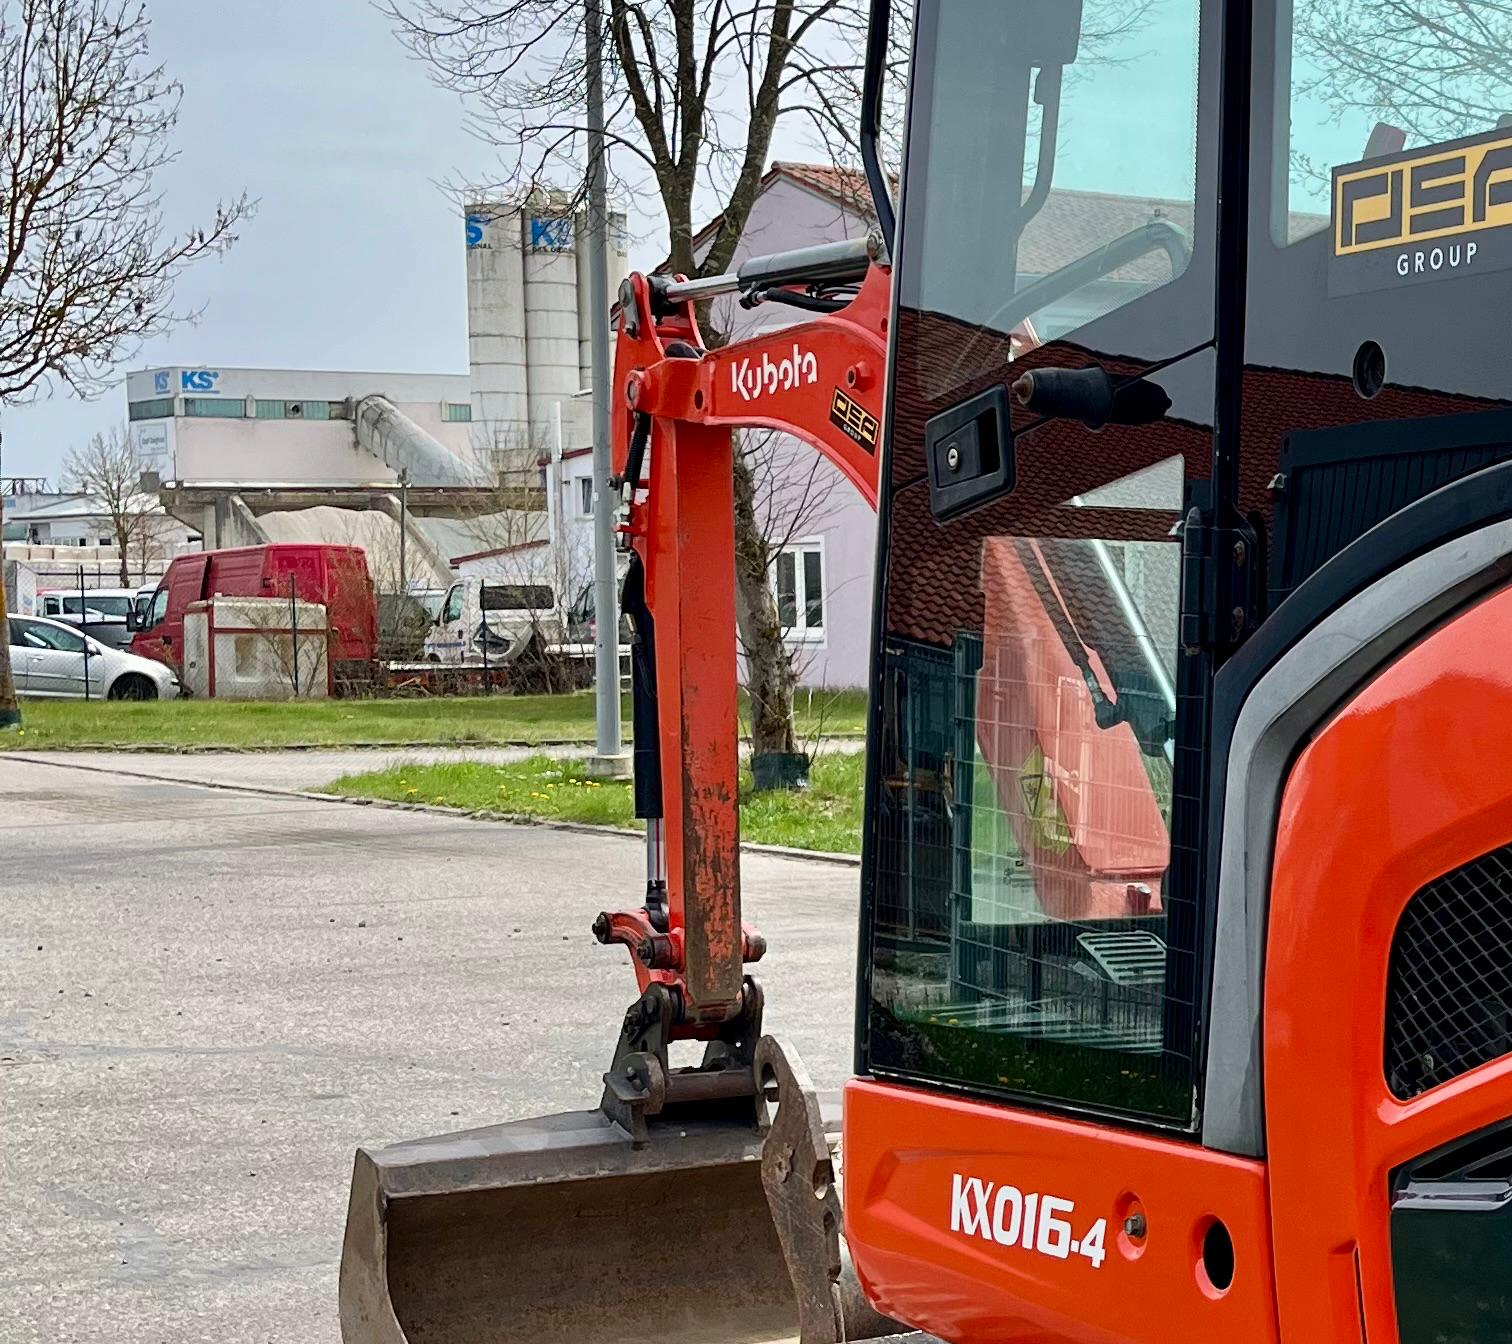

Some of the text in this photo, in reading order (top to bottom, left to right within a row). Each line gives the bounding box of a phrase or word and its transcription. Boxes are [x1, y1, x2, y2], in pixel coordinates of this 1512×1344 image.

[1396, 242, 1477, 276] GROUP
[731, 343, 817, 400] Kubota
[843, 423, 862, 441] GROUP
